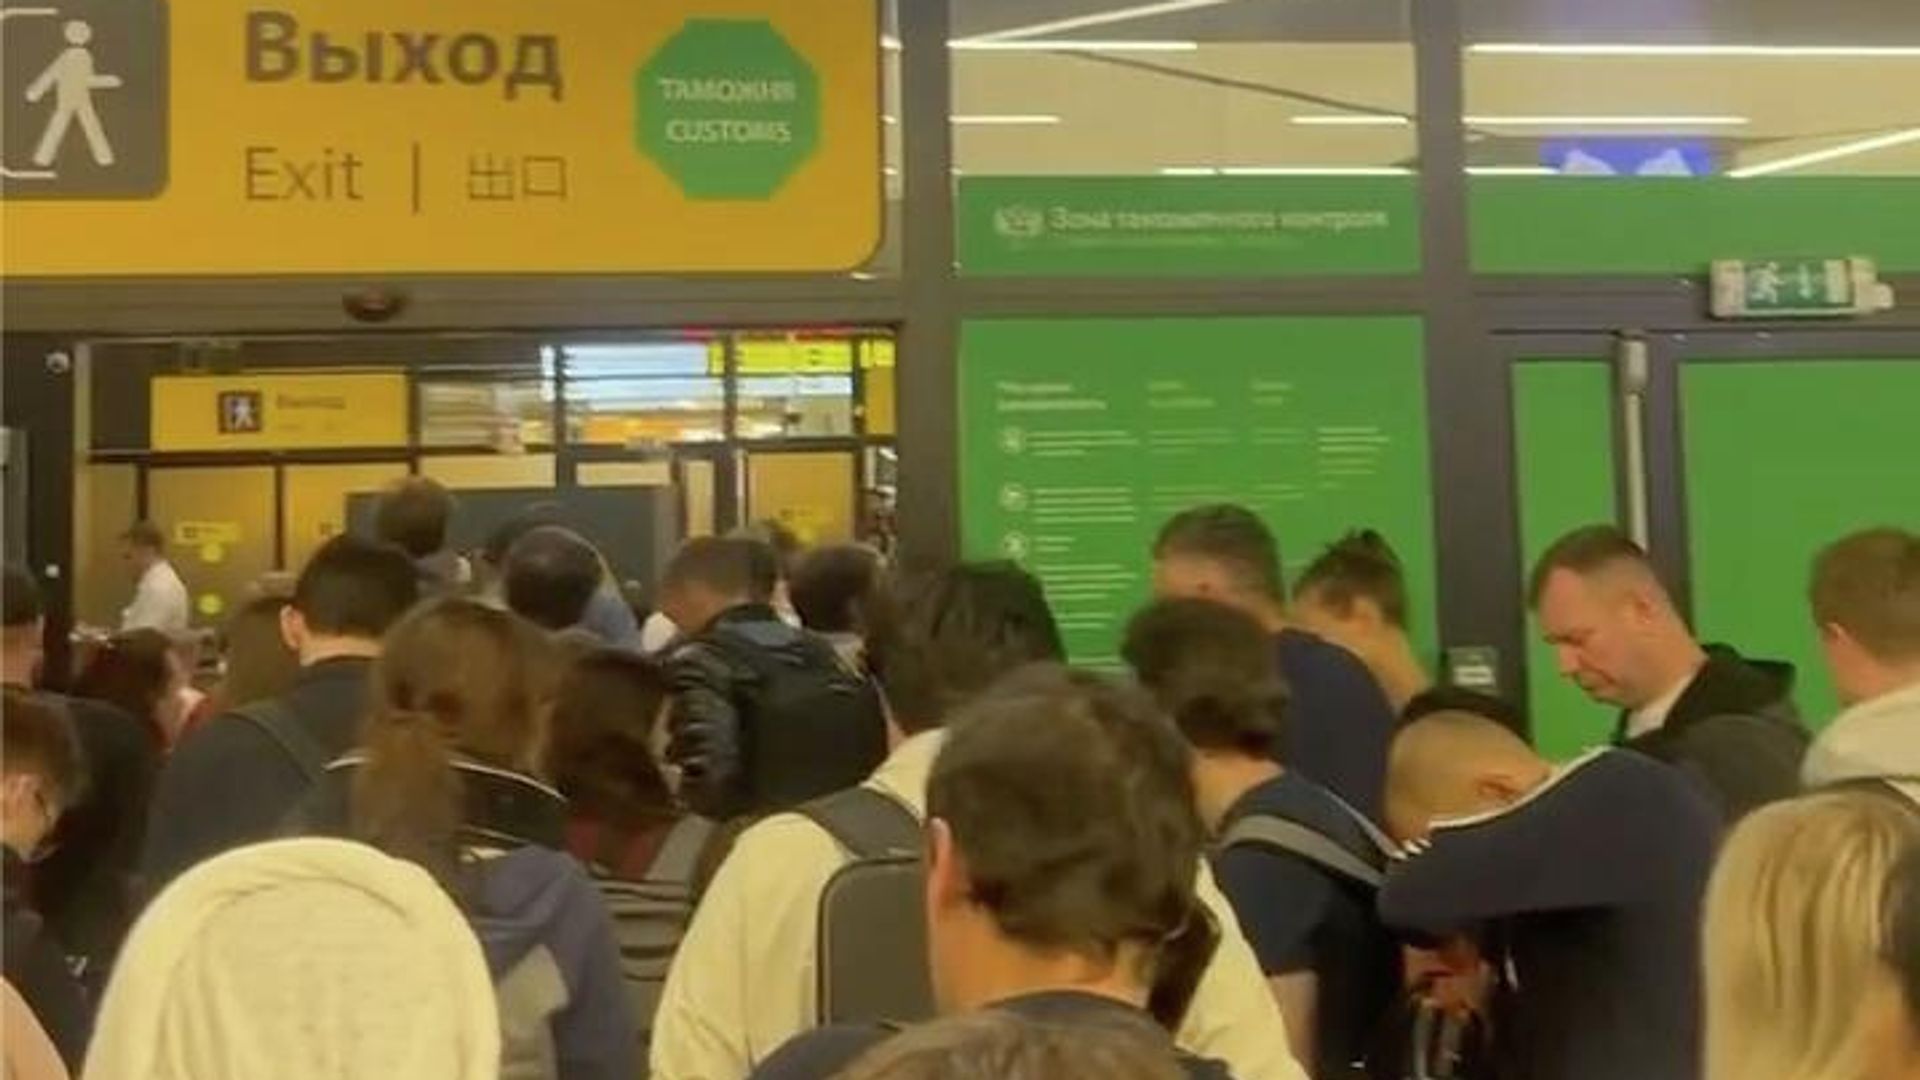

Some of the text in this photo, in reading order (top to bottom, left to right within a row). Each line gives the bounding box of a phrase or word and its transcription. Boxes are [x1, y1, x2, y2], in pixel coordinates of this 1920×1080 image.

[246, 10, 563, 102] Выход
[666, 119, 792, 143] CUSTOMS
[245, 146, 568, 201] Exit 出口
